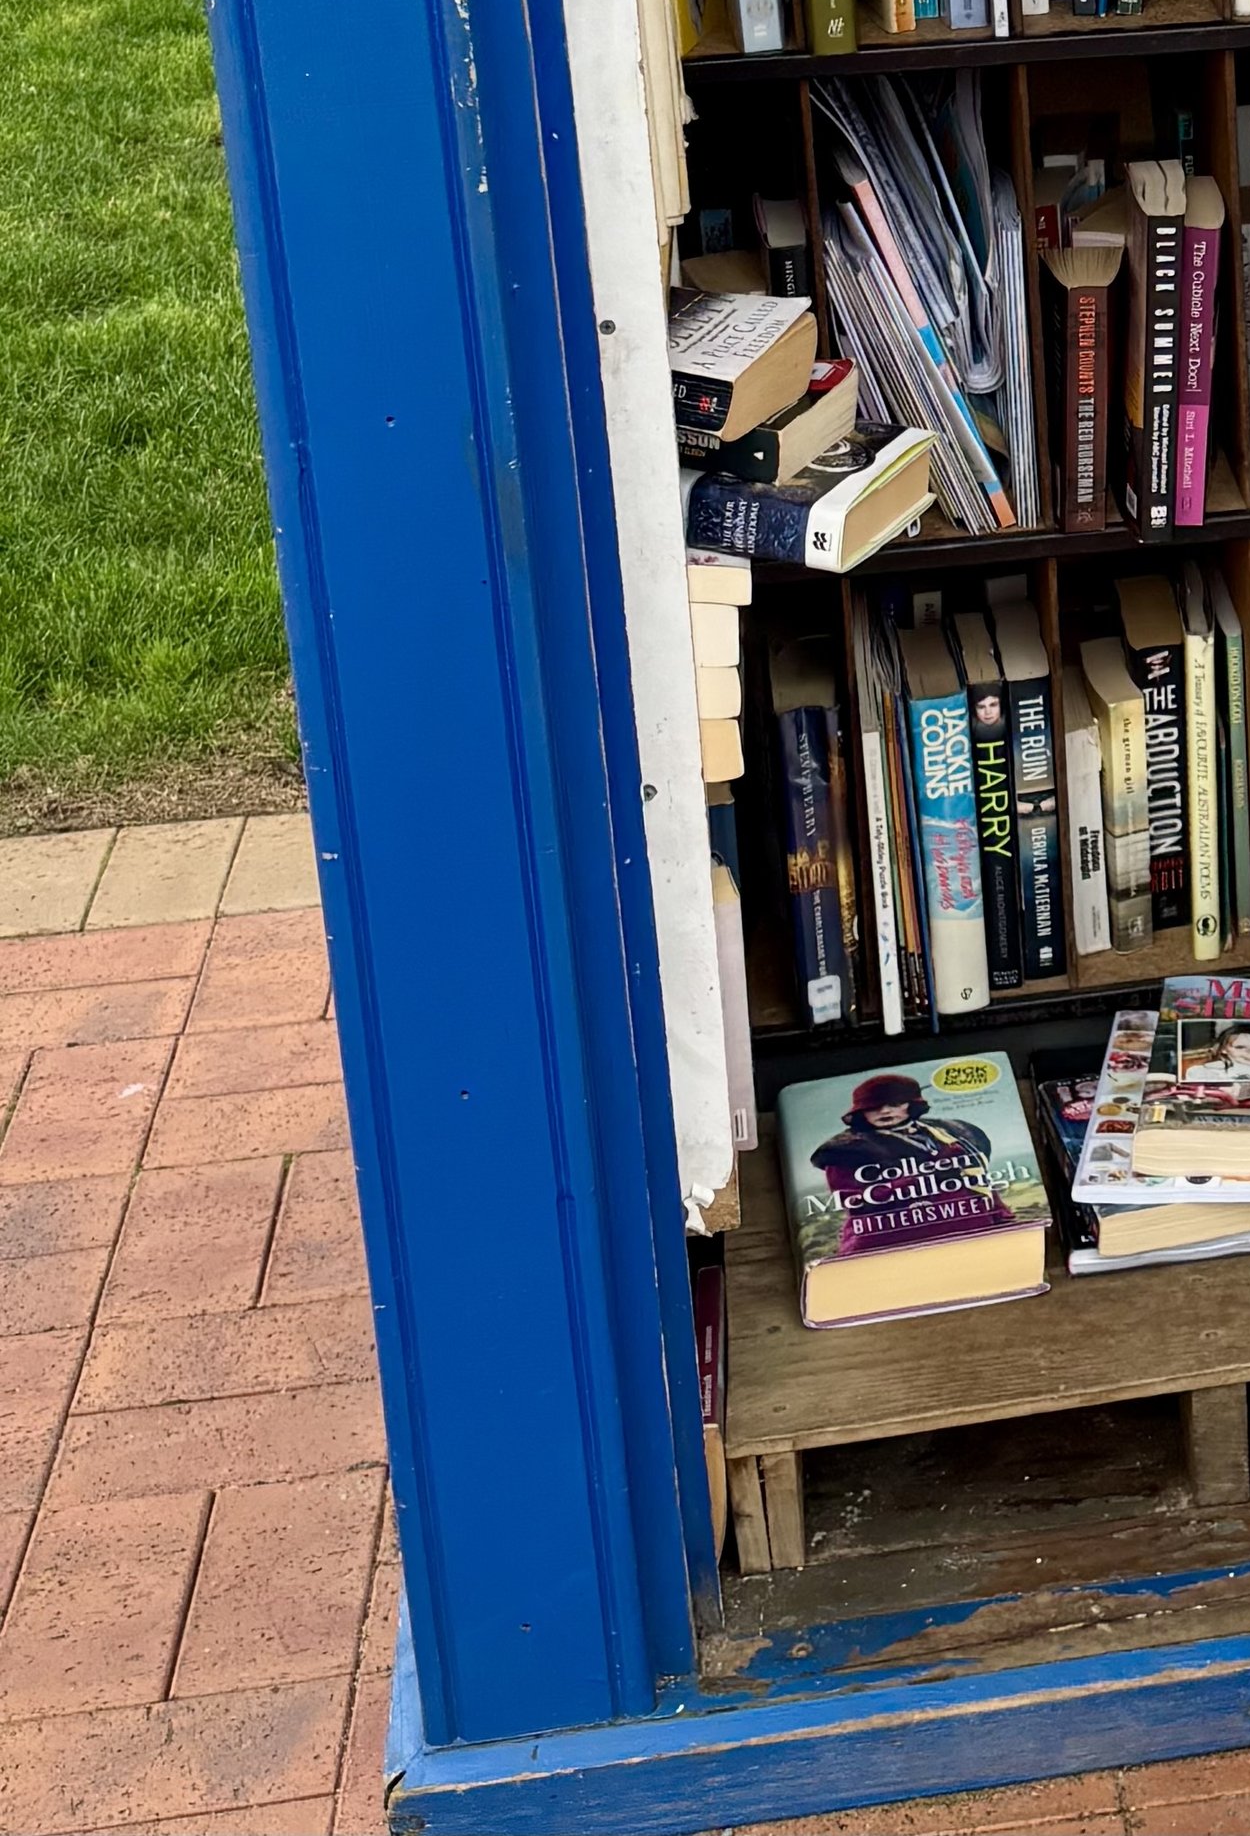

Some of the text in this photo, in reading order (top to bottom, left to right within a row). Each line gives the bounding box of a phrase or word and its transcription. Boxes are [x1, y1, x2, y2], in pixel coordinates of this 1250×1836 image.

[1077, 296, 1096, 348] STEPHEN
[1151, 225, 1178, 393] BLACK SUMMER
[1185, 240, 1208, 390] The Cubicle Next Door
[1076, 397, 1095, 442] THE RED
[1182, 445, 1196, 490] Mitchell
[1017, 694, 1043, 733] THE
[1143, 684, 1177, 712] THE
[920, 708, 948, 801] COLLINS
[942, 706, 973, 796] JACKIE
[976, 740, 1012, 858] HARRY
[1145, 713, 1184, 855] ABDUCTION
[801, 785, 817, 837] BERRY
[1198, 784, 1211, 859] AUSTRALIAN
[1031, 826, 1049, 873] DERVLA
[1200, 860, 1212, 901] POEMS
[803, 1160, 1030, 1216] McCullough
[854, 1152, 970, 1184] Colleen
[852, 1197, 996, 1235] BITTERSWEET
